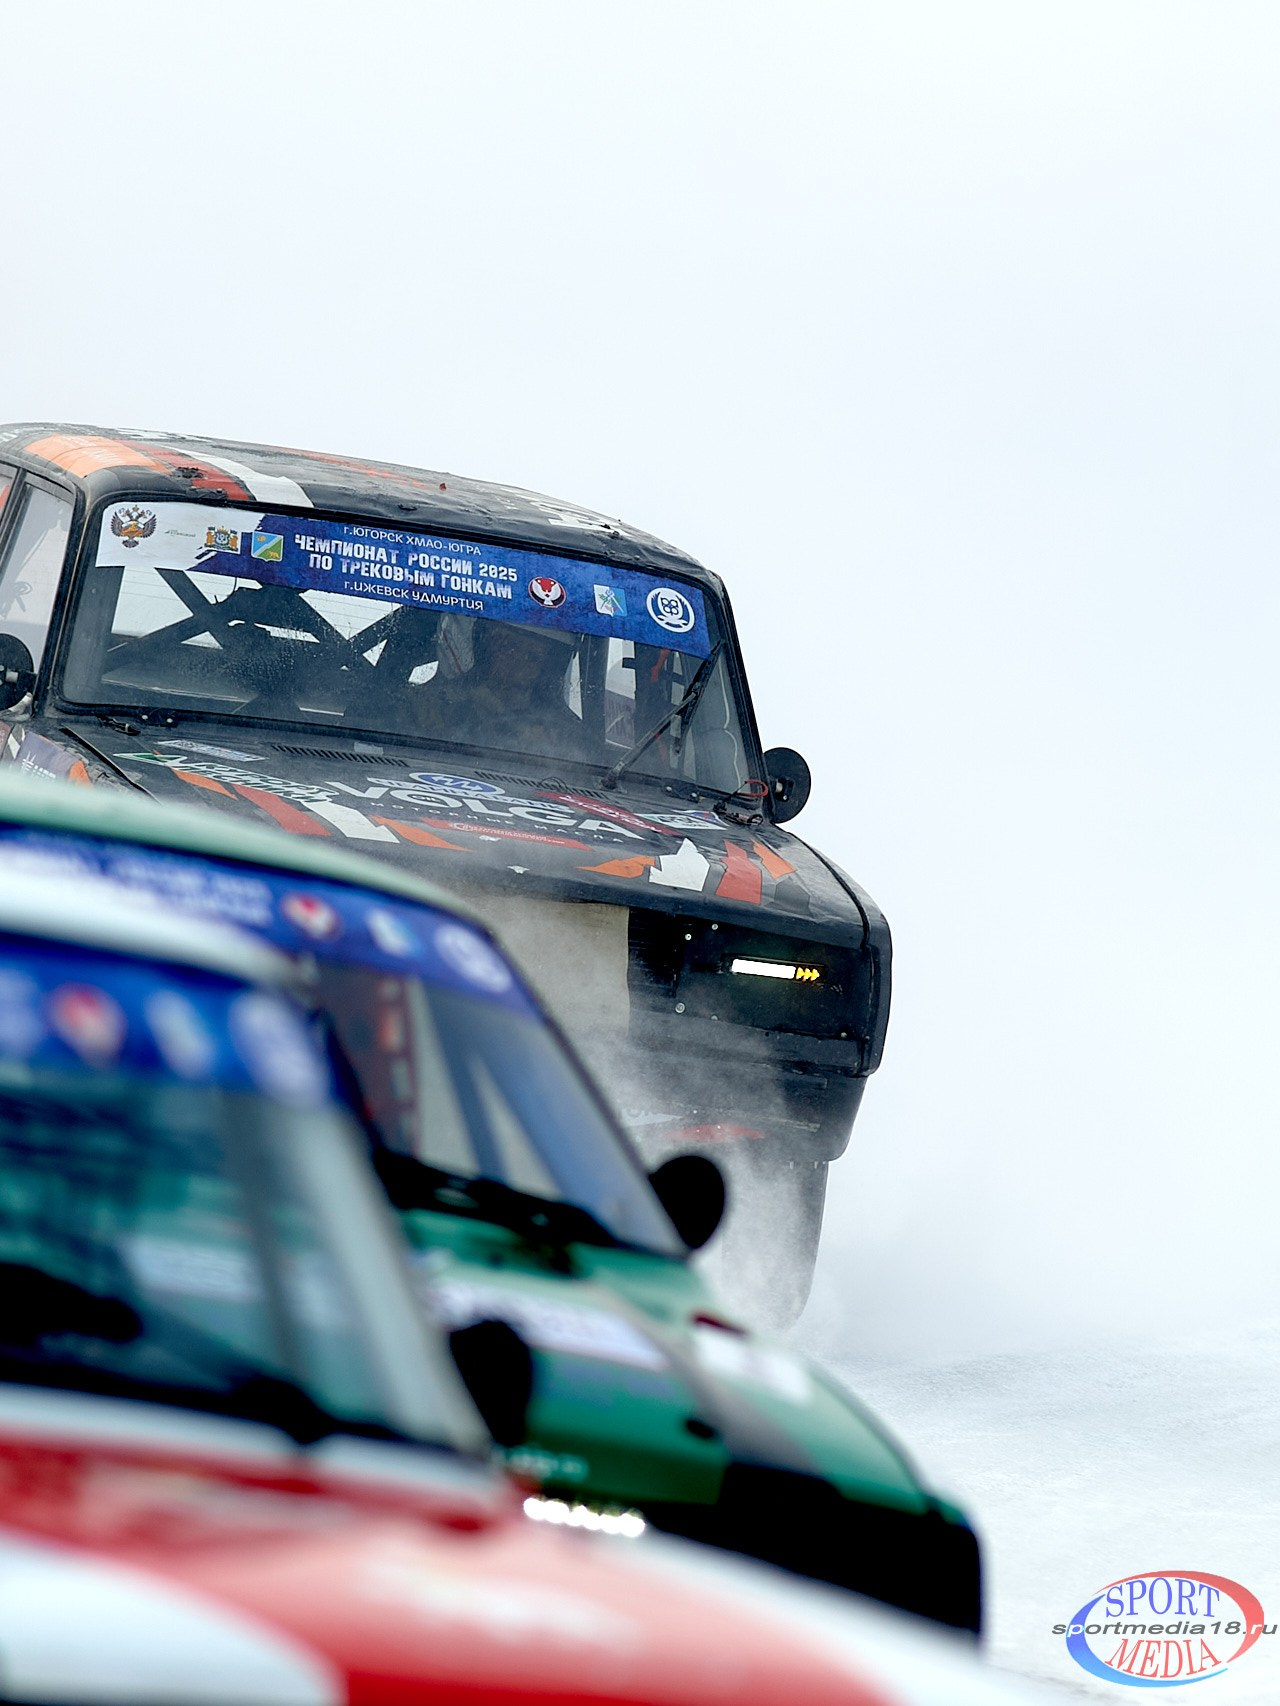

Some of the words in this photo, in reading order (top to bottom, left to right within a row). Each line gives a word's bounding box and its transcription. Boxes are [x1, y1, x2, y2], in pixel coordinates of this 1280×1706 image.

[295, 534, 399, 565] ЧЕМПИОНАТ
[408, 551, 472, 576] РОССИИ
[479, 562, 518, 582] 2025
[343, 526, 403, 544] г.ЮГОРСК
[406, 535, 482, 556] ХМАО-ЮГРА
[309, 553, 333, 571] ПО
[340, 558, 435, 587] ТРЕКОВЫМ
[441, 577, 513, 600] ГОНКАМ
[344, 581, 409, 600] г.ИЖЕВСК
[412, 591, 484, 611] УДМУРТИЯ
[325, 781, 645, 841] VOLGA
[371, 802, 515, 825] МОТОРНЫЕ
[534, 824, 624, 843] МАСЛА
